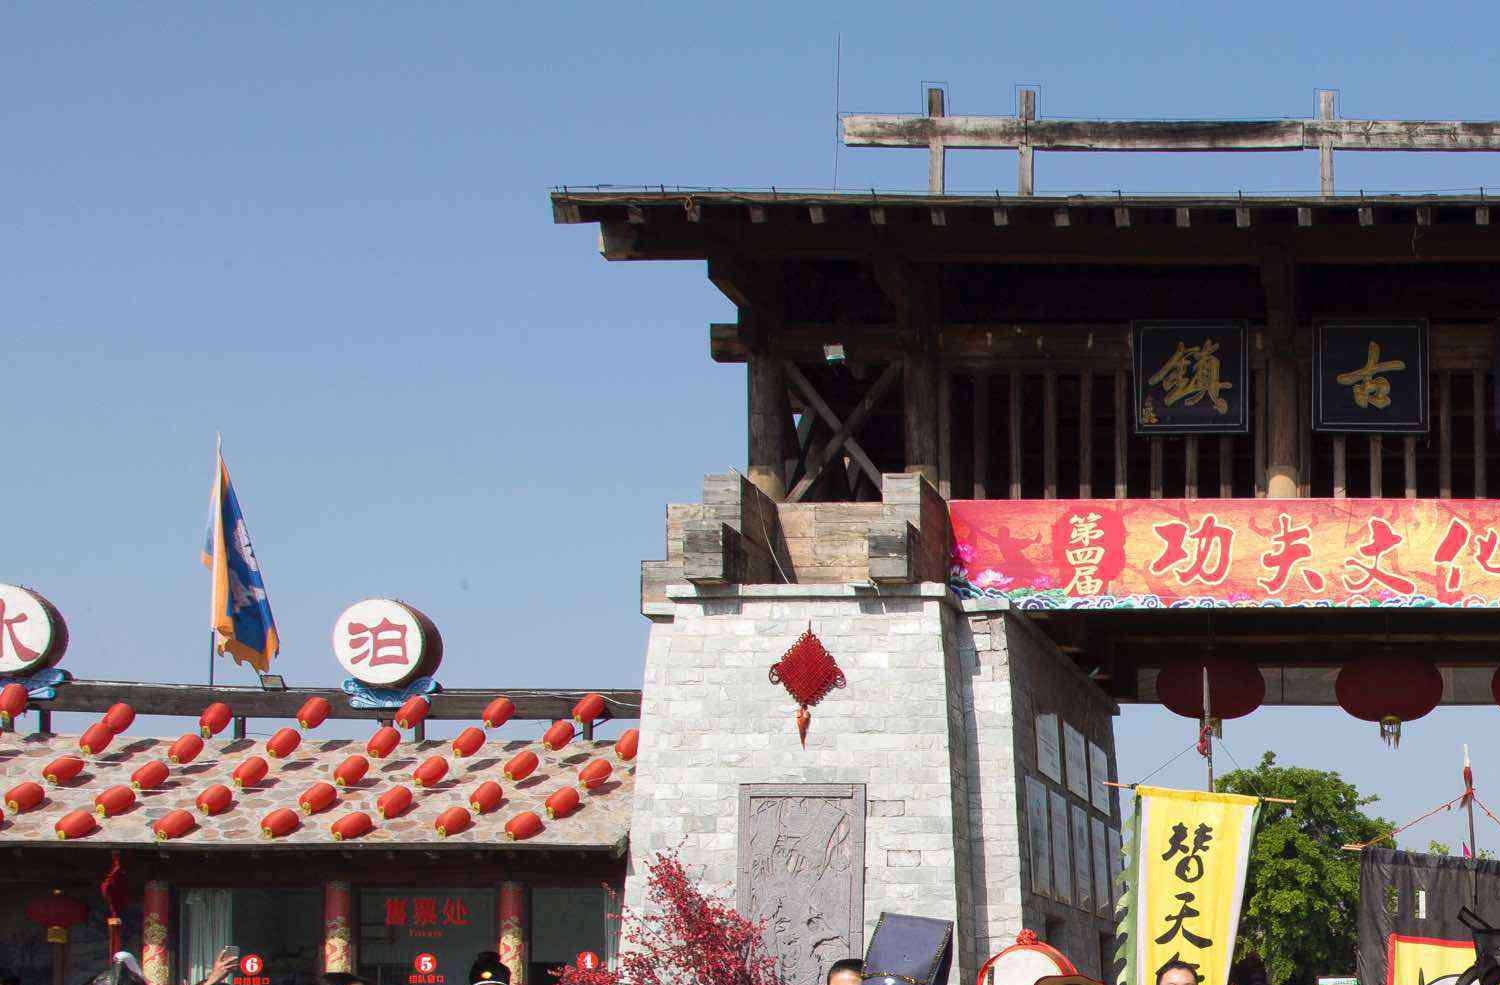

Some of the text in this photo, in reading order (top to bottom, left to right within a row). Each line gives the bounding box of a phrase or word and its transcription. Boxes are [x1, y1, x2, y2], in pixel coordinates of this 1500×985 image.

[1064, 513, 1105, 598] 第四届
[348, 617, 409, 667] 泊
